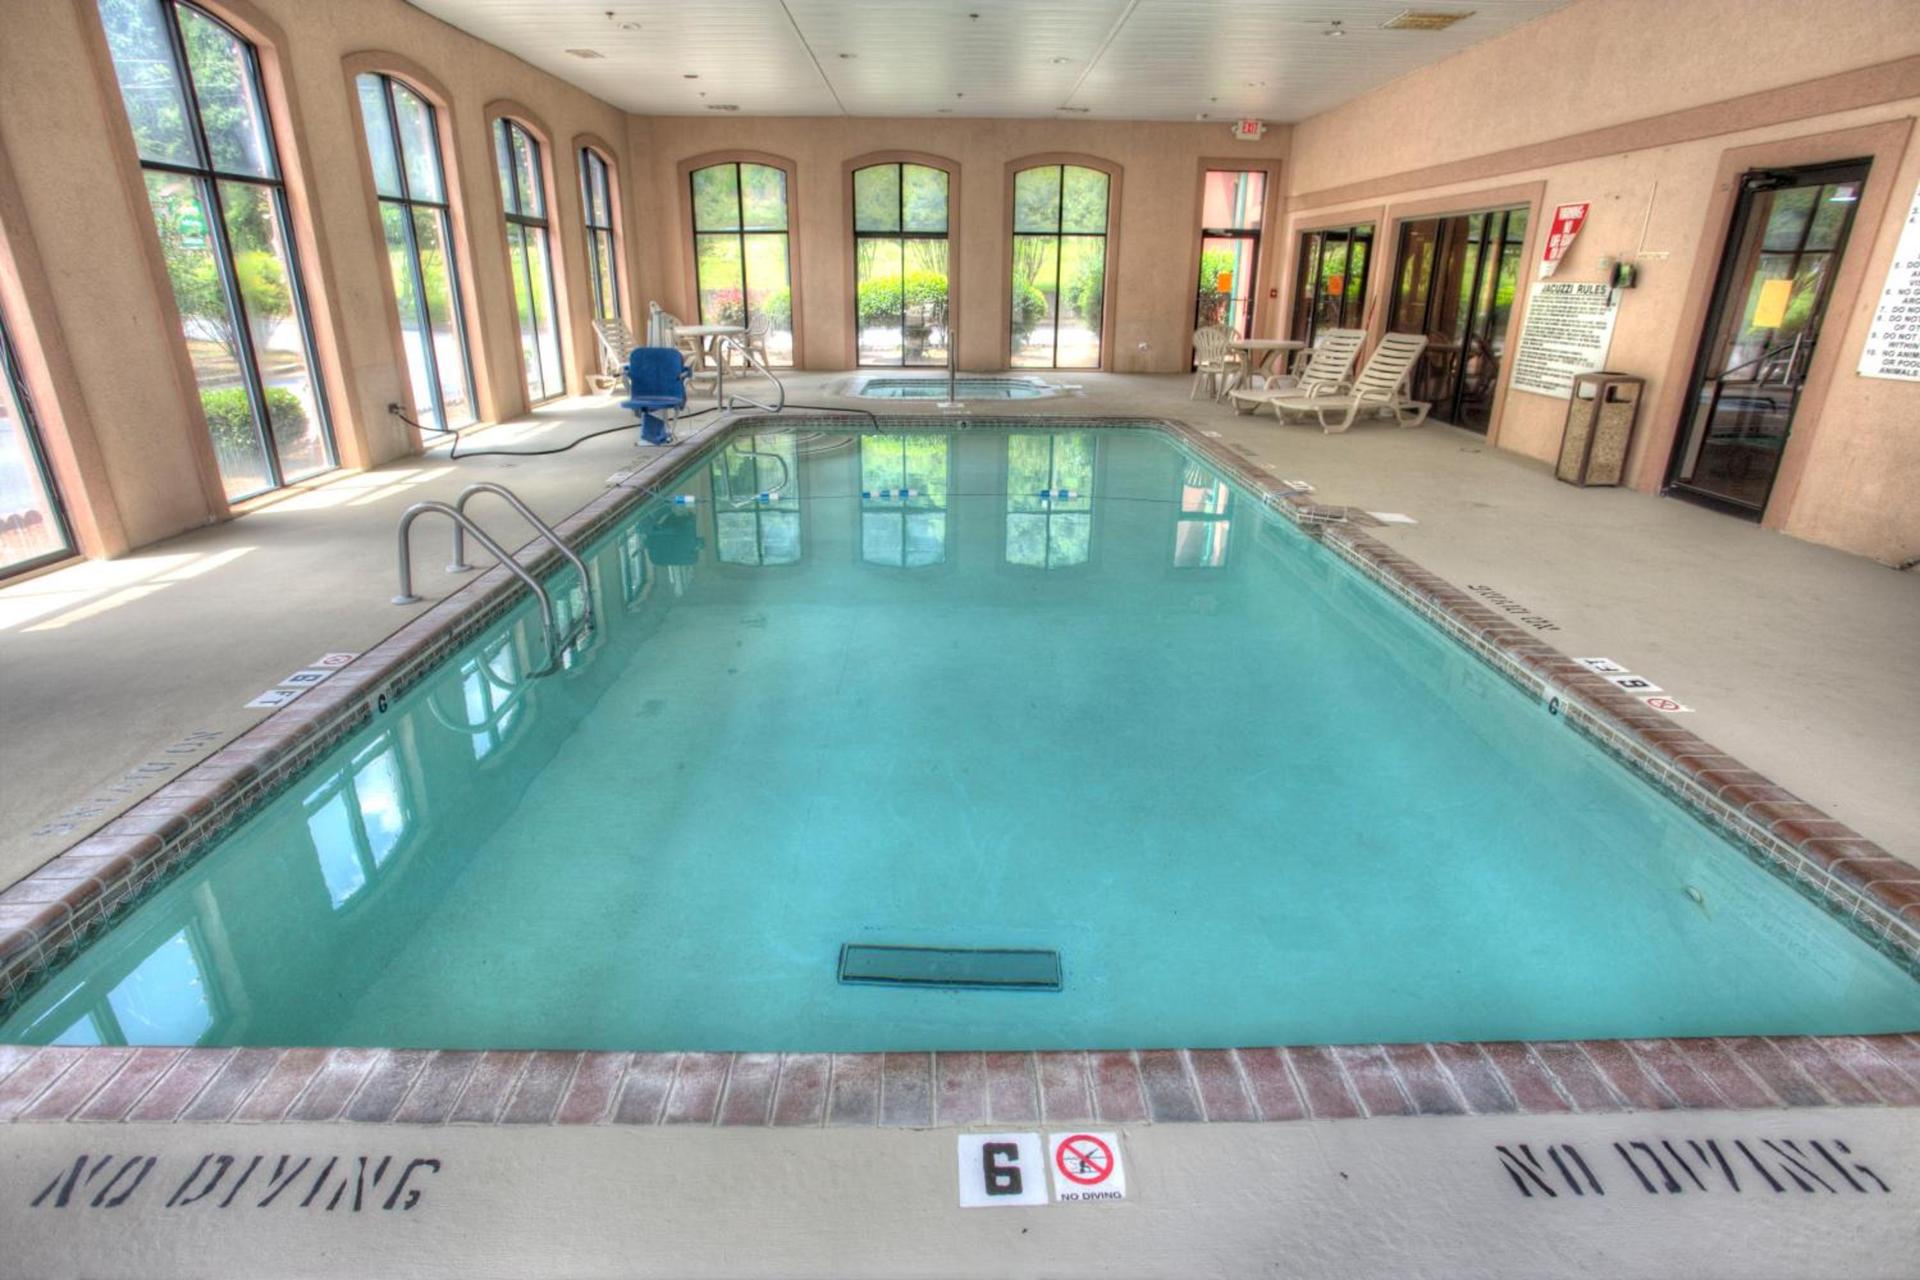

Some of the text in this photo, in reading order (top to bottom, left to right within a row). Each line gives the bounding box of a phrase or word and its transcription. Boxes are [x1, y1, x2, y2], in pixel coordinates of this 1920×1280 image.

[1542, 284, 1607, 295] JACUZZI RULES
[1883, 332, 1896, 340] DO
[1898, 333, 1917, 341] NOT
[30, 1153, 441, 1212] NO DIVING
[982, 1142, 1023, 1196] 6
[1494, 1138, 1891, 1198] NO DIVING
[1061, 1190, 1122, 1201] NO DIVING
